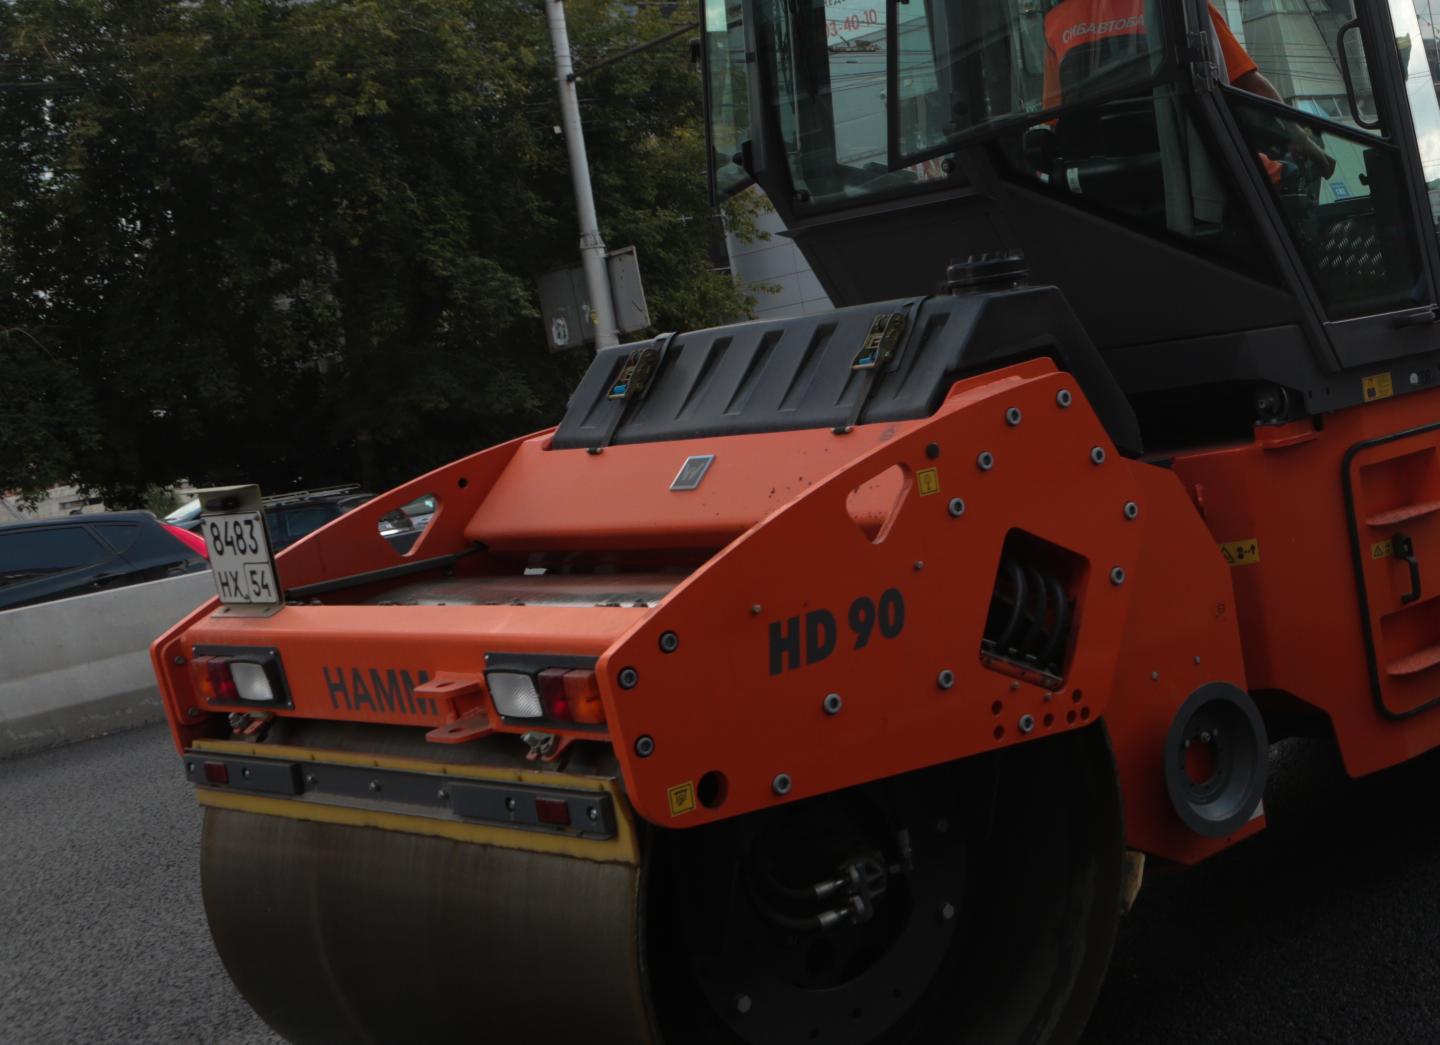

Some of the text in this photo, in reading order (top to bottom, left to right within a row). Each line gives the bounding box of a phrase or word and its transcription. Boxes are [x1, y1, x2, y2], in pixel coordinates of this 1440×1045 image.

[826, 9, 877, 37] 3-40-10
[211, 520, 258, 556] 8483
[250, 570, 271, 597] 54
[769, 587, 905, 676] HD 90
[322, 666, 438, 716] HAMM
